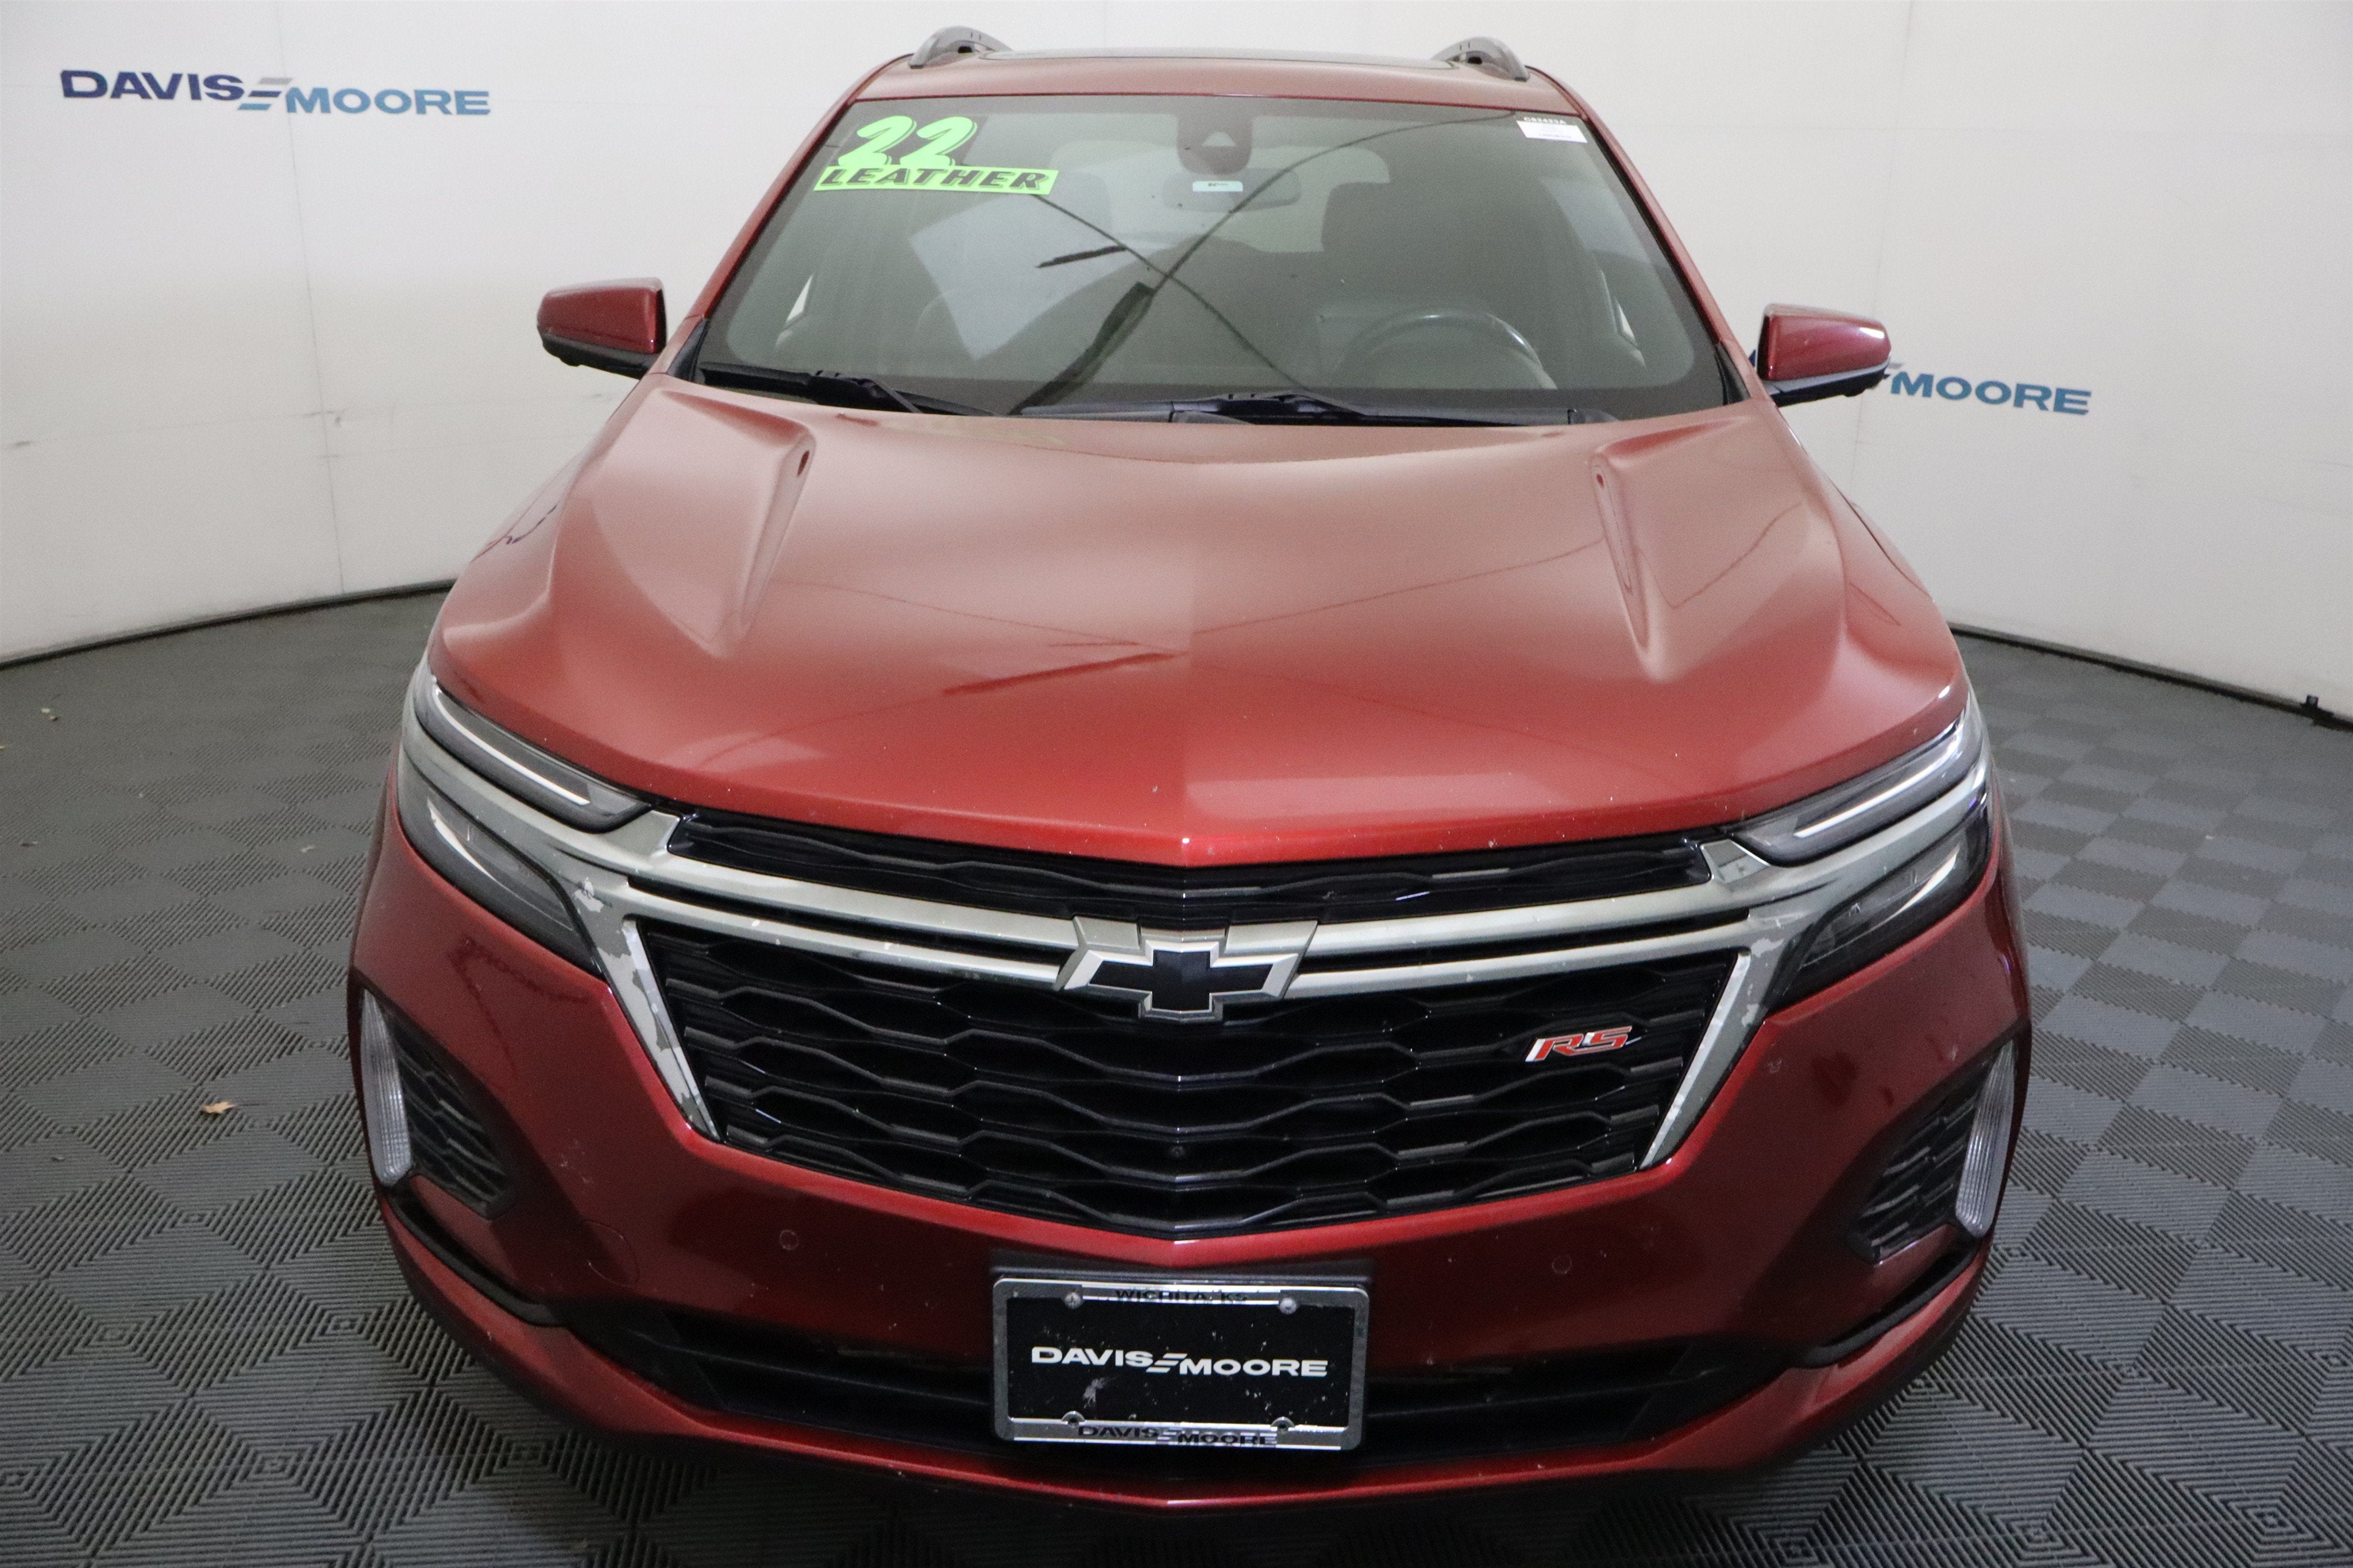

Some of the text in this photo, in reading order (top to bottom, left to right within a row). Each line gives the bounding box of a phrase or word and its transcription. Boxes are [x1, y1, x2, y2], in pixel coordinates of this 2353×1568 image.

[60, 69, 491, 115] DAVIS MOORE
[838, 116, 977, 166] 22
[820, 167, 1048, 191] LEATHER
[1891, 370, 2091, 415] MOORE
[1525, 1026, 1632, 1062] RS
[1032, 1347, 1328, 1376] DAVIS MOORE
[1078, 1425, 1278, 1446] DAVIS MOORE
